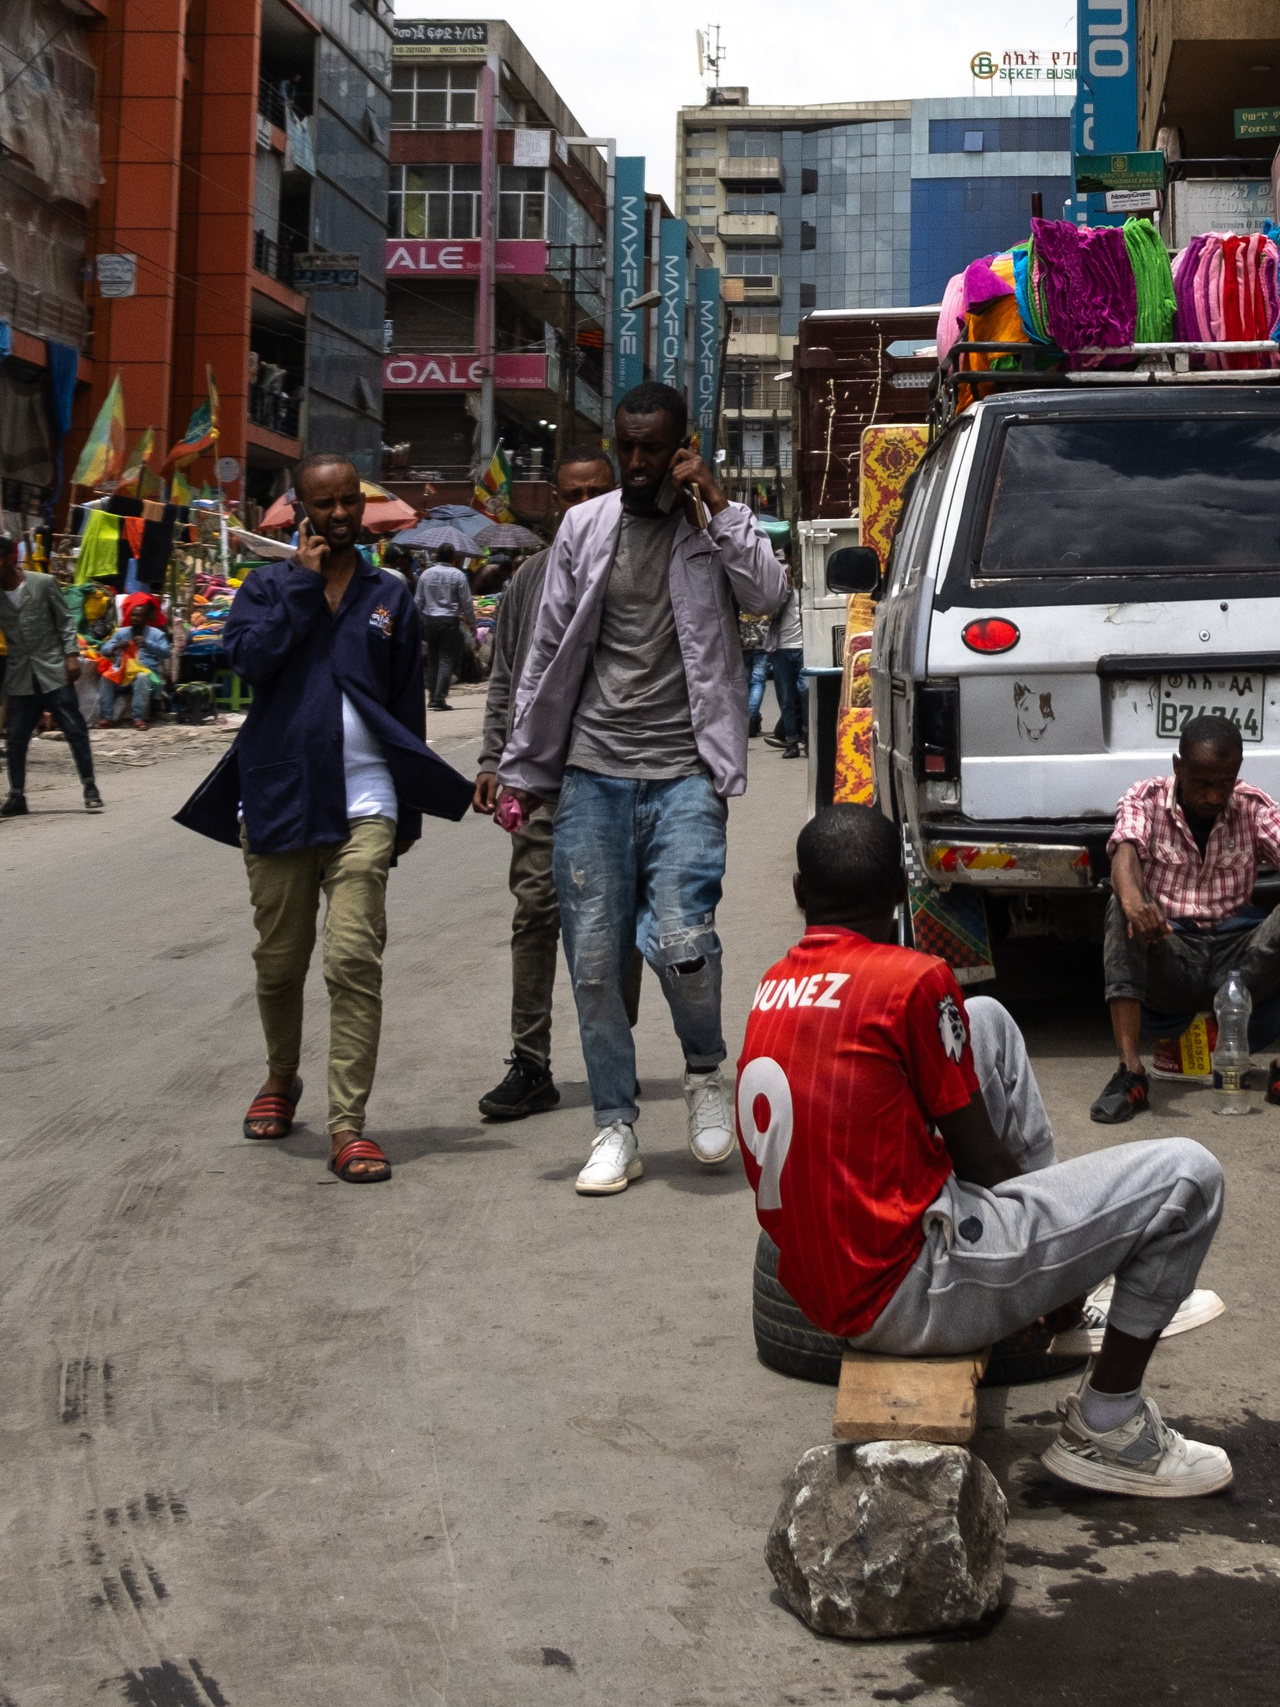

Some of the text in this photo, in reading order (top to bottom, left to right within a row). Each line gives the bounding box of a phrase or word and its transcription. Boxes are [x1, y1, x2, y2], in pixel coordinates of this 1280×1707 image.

[1000, 68, 1041, 80] SEKET
[1240, 125, 1277, 134] Forex
[619, 195, 638, 355] MAXFONE
[518, 376, 542, 384] Mobile
[699, 300, 714, 429] MAXFONE
[738, 1056, 794, 1210] 9
